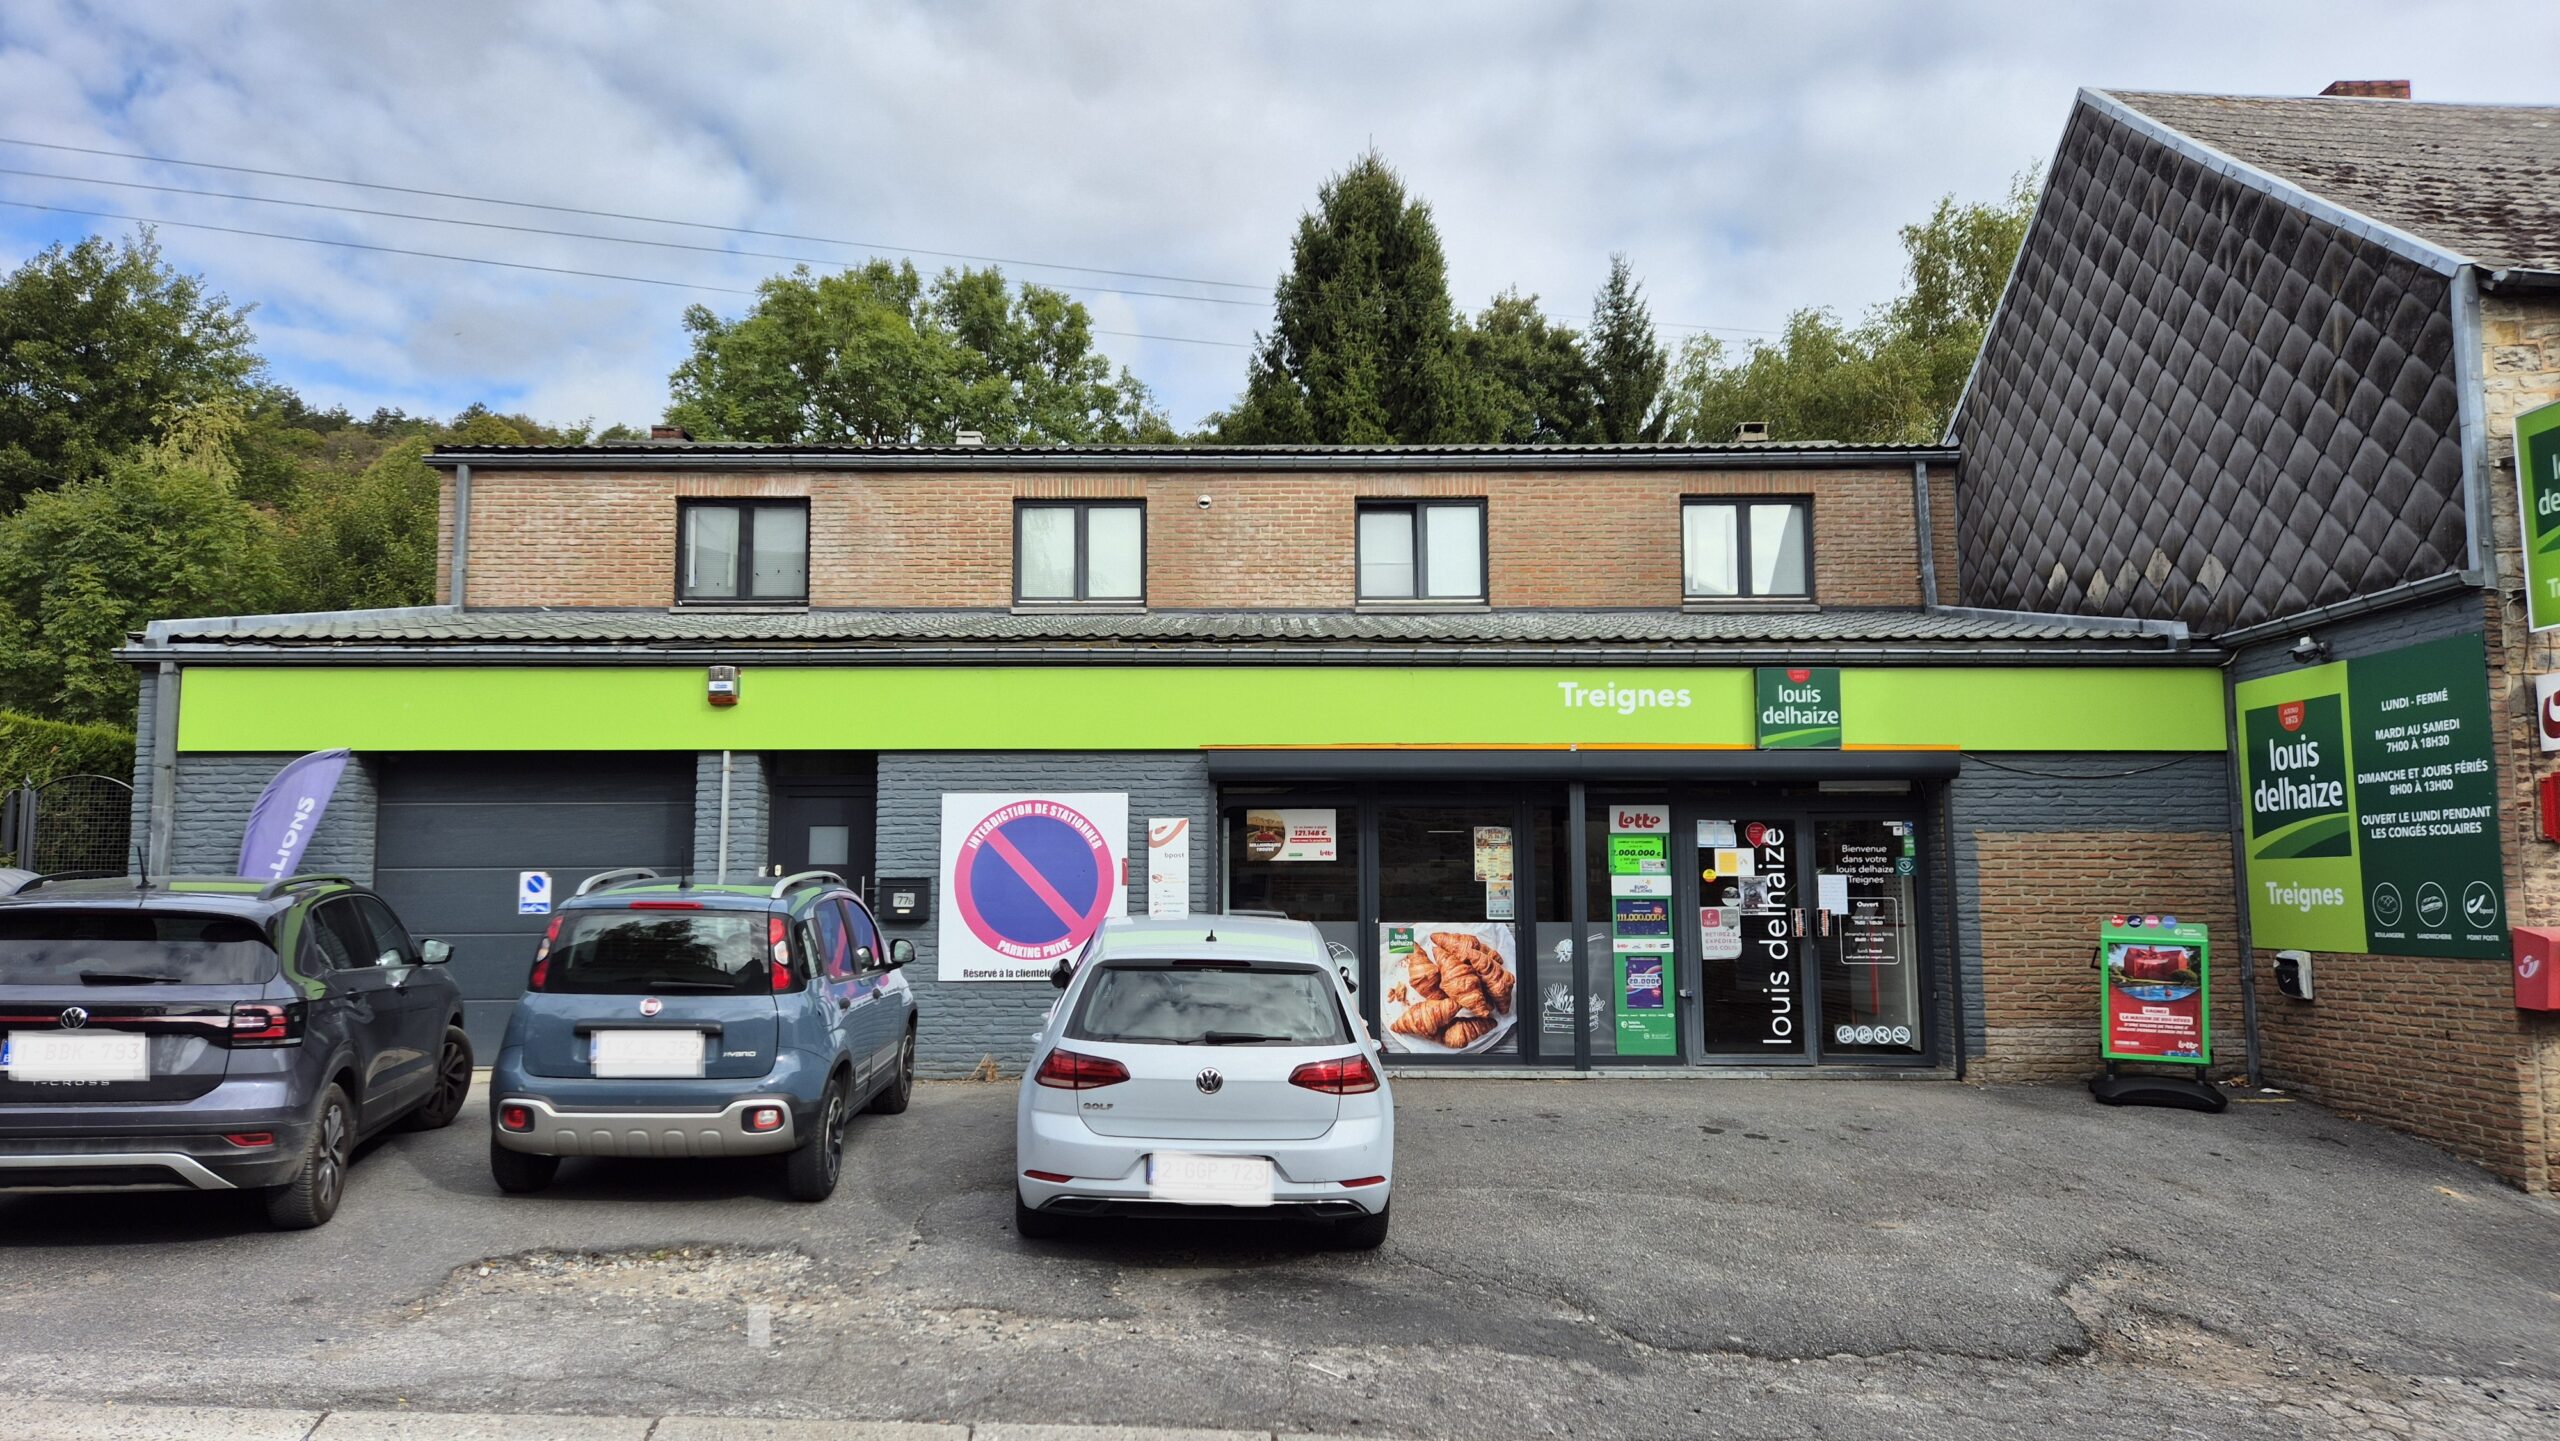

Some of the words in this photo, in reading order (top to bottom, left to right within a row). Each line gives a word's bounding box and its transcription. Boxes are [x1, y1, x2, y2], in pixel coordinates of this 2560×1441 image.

[1557, 681, 1692, 715] Treignes
[1778, 685, 1821, 703] louis
[2381, 697, 2409, 712] LUNDI
[2416, 687, 2448, 706] FERMÉ
[1762, 706, 1839, 725] delhaize
[2375, 727, 2405, 740] MARDI
[2407, 724, 2420, 736] AU
[2422, 718, 2460, 734] SAMEDI
[2269, 734, 2319, 771] louis
[2386, 740, 2409, 753] 7H00
[2411, 737, 2419, 750] À
[2420, 734, 2450, 748] 18H30
[2357, 769, 2406, 784] DIMANCHE
[2408, 768, 2419, 779] ET
[2421, 764, 2452, 778] JOURS
[2454, 758, 2488, 774] FÉRIÉS
[2254, 774, 2343, 812] delhaize
[2389, 783, 2412, 795] 8H00
[2414, 780, 2422, 793] À
[2424, 779, 2453, 792] 13H00
[2361, 813, 2397, 825] OUVERT
[2398, 812, 2409, 823] LE
[2411, 809, 2440, 822] LUNDI
[2442, 806, 2492, 820] PENDANT
[967, 803, 1033, 850] INTERDICTION
[1034, 803, 1048, 814] DE
[1049, 805, 1103, 850] STATIONNER
[2371, 828, 2386, 839] LES
[2388, 823, 2427, 838] CONGÉS
[2429, 821, 2482, 836] SCOLAIRES
[1841, 844, 1887, 852] Bienvenue
[1842, 855, 1863, 863] dans
[1836, 865, 1856, 873] louis
[1858, 865, 1894, 873] delhaize
[1847, 875, 1884, 885] Treignes
[1757, 828, 1789, 960] delhaize
[2265, 881, 2344, 912] Treignes
[996, 940, 1042, 958] PARKING
[963, 969, 997, 978] Réservé
[999, 969, 1004, 978] à
[1006, 969, 1014, 978] la
[1762, 970, 1792, 1043] louis
[1083, 1102, 1114, 1110] GOLF
